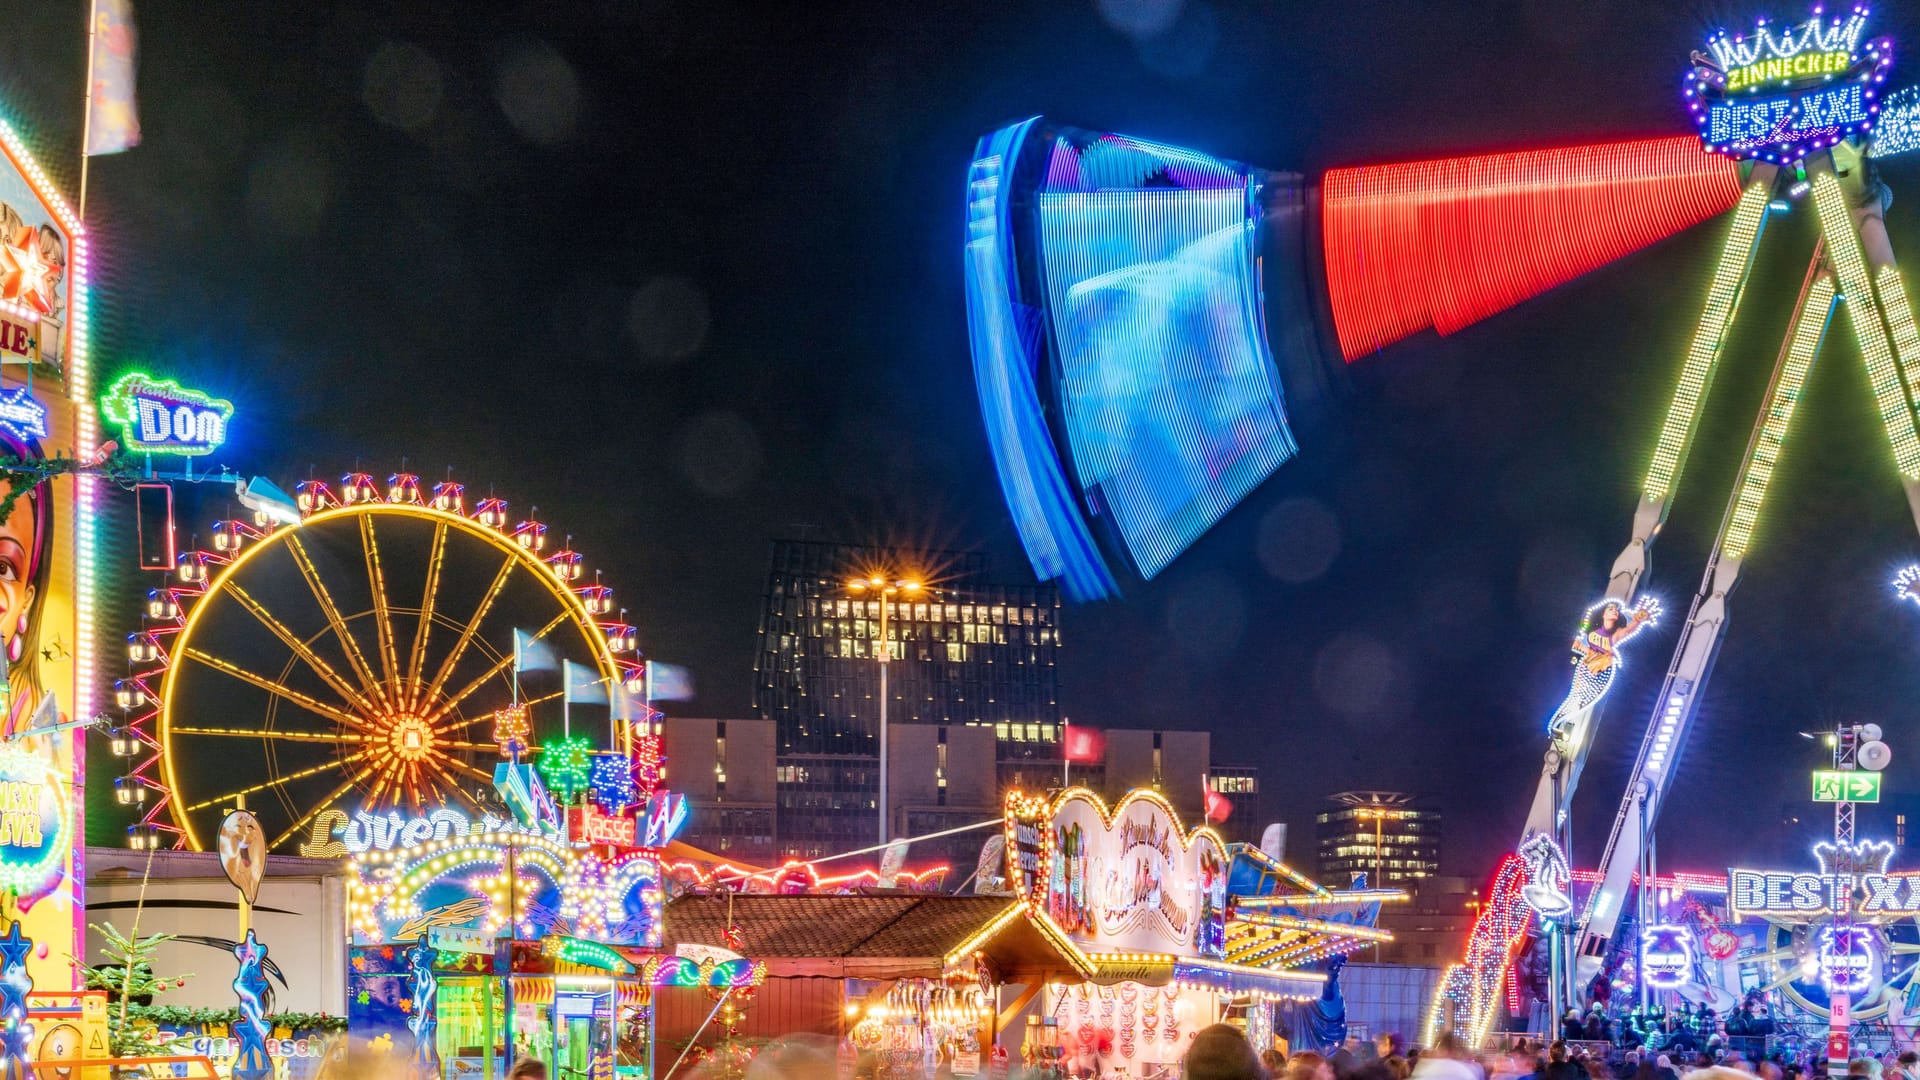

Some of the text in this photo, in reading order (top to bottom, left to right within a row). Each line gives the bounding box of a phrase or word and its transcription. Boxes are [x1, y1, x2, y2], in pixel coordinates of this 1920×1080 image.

[1727, 51, 1849, 90] ZINNECKER
[1711, 99, 1790, 143] BEST
[1799, 86, 1868, 128] XXL
[0, 811, 43, 848] EVEL
[582, 803, 635, 846] Kasse
[1736, 873, 1850, 911] BEST
[1833, 1004, 1844, 1017] 15
[265, 1034, 325, 1058] asch
